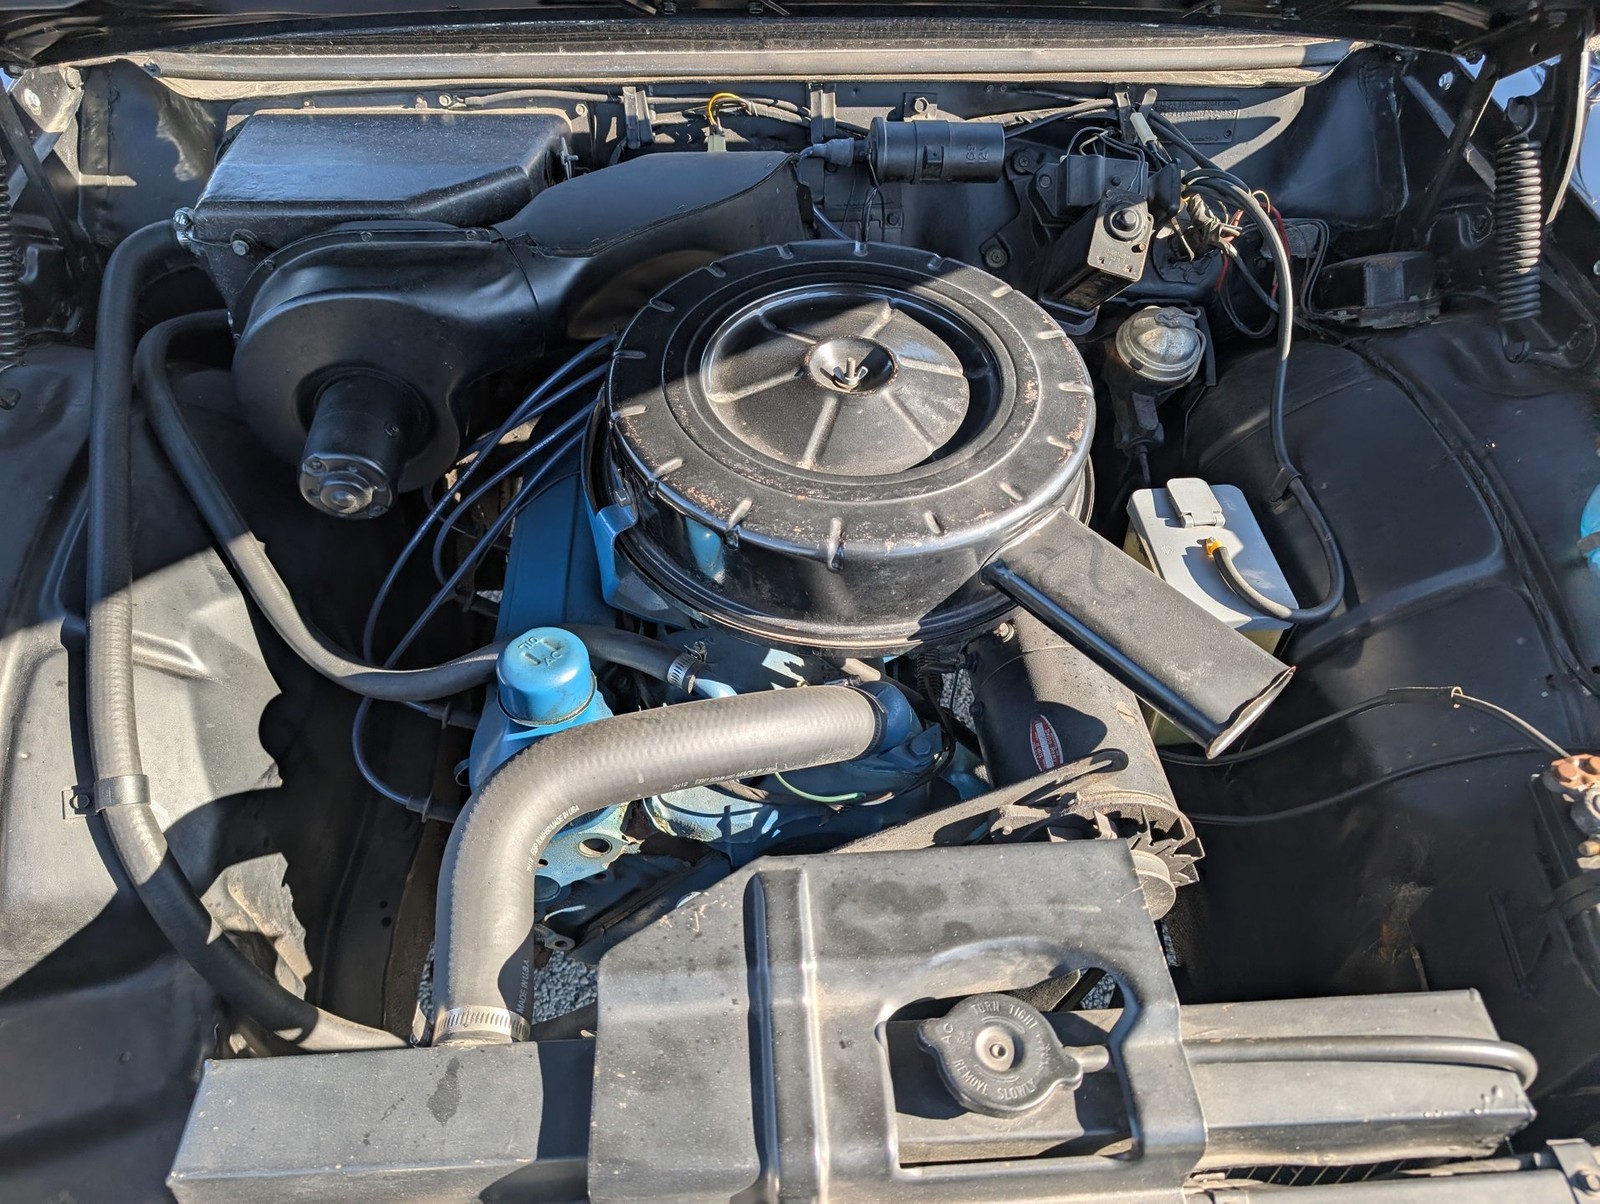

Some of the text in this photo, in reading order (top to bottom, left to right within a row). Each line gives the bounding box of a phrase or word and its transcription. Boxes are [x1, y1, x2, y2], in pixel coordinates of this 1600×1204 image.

[518, 636, 539, 650] OIL
[544, 651, 562, 666] AC
[521, 980, 529, 990] IN
[516, 989, 527, 1014] MADE
[971, 1001, 1038, 1029] TURN TIGHT
[953, 1059, 1037, 1100] REMOVE SLOWLY
